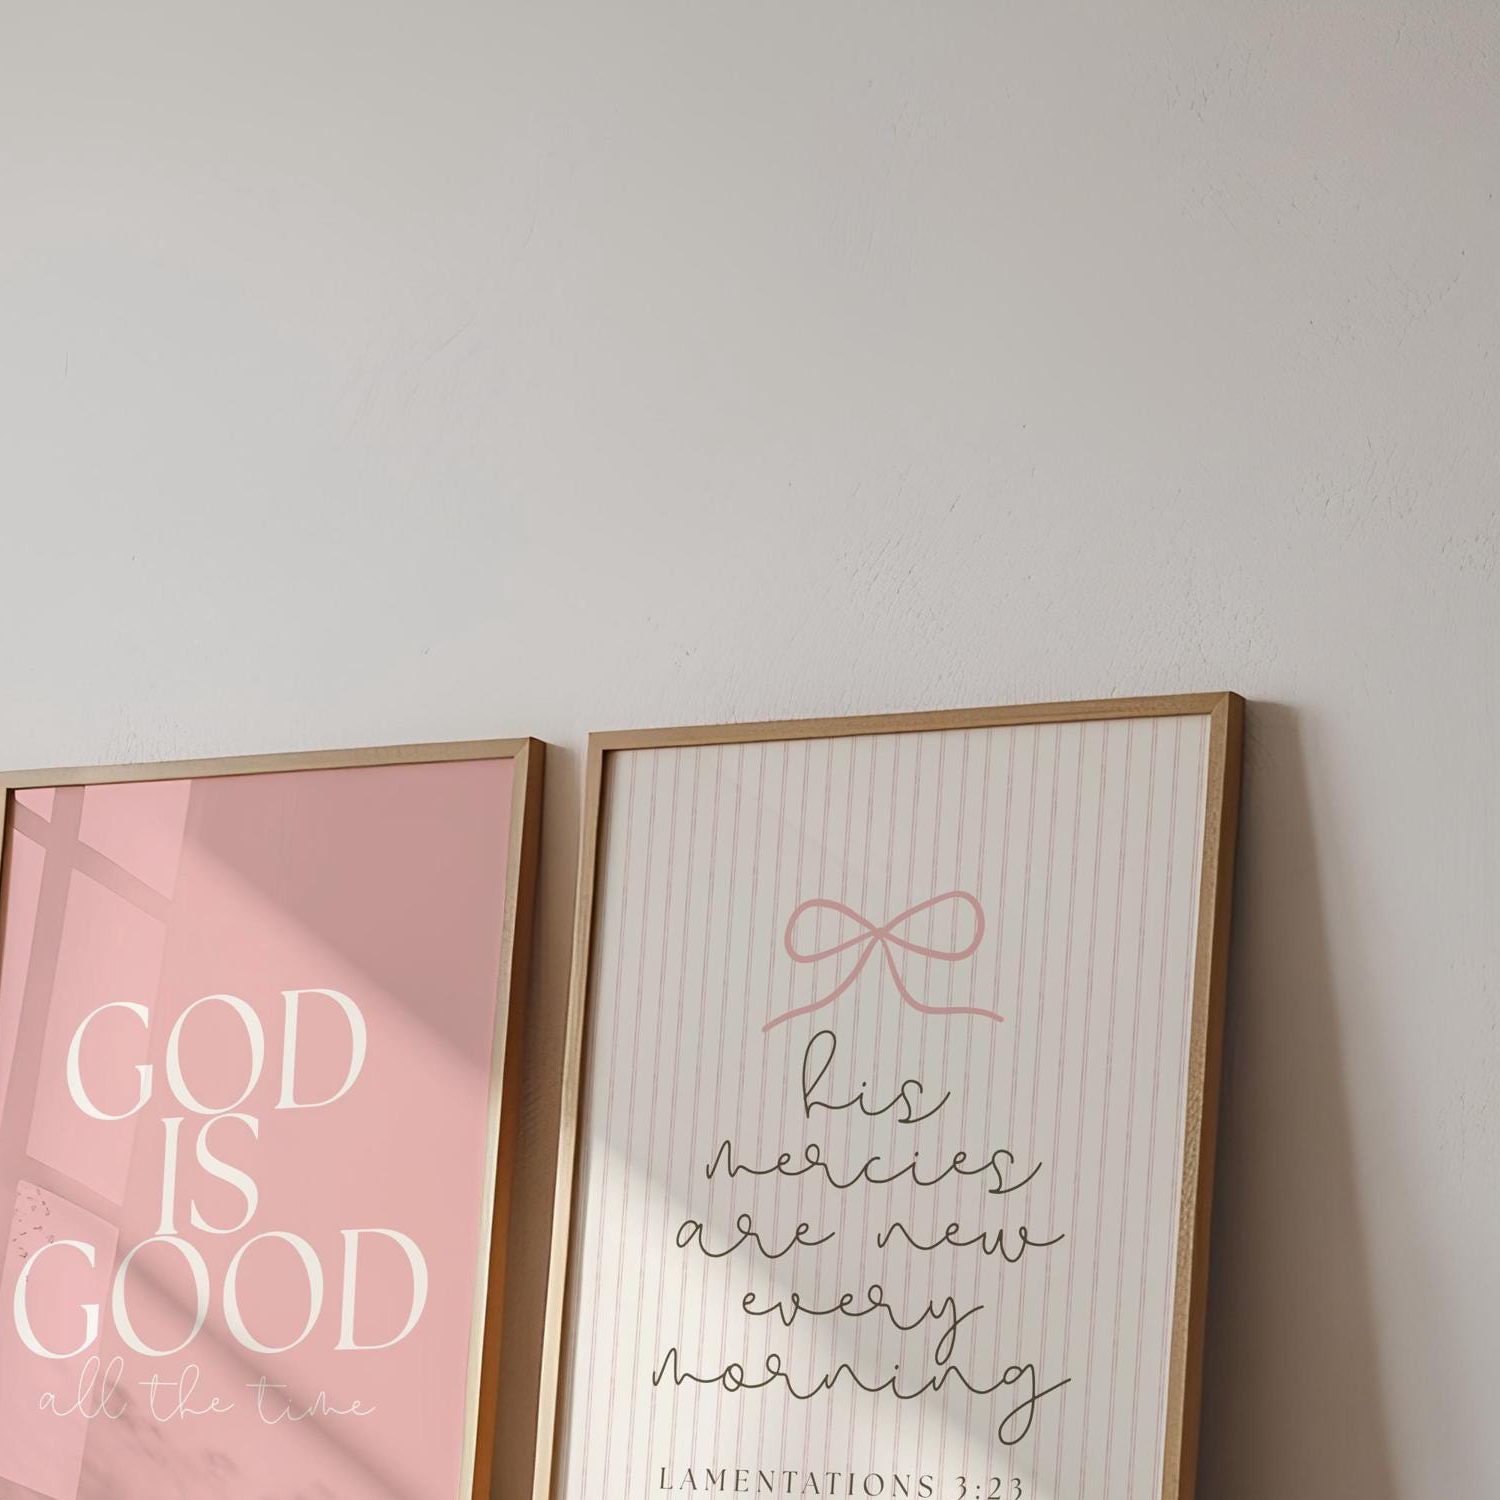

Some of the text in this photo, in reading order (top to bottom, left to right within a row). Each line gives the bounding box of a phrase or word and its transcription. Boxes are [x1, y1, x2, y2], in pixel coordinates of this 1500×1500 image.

[66, 988, 367, 1121] GOD
[802, 1030, 951, 1124] his
[155, 1113, 259, 1235] IS
[706, 1140, 1043, 1194] mercies
[676, 1213, 1066, 1263] are new
[13, 1228, 429, 1359] GOOD
[743, 1284, 985, 1366] every
[39, 1355, 377, 1425] all the time
[652, 1347, 1072, 1446] morning
[659, 1467, 936, 1500] LAMENTATIONS
